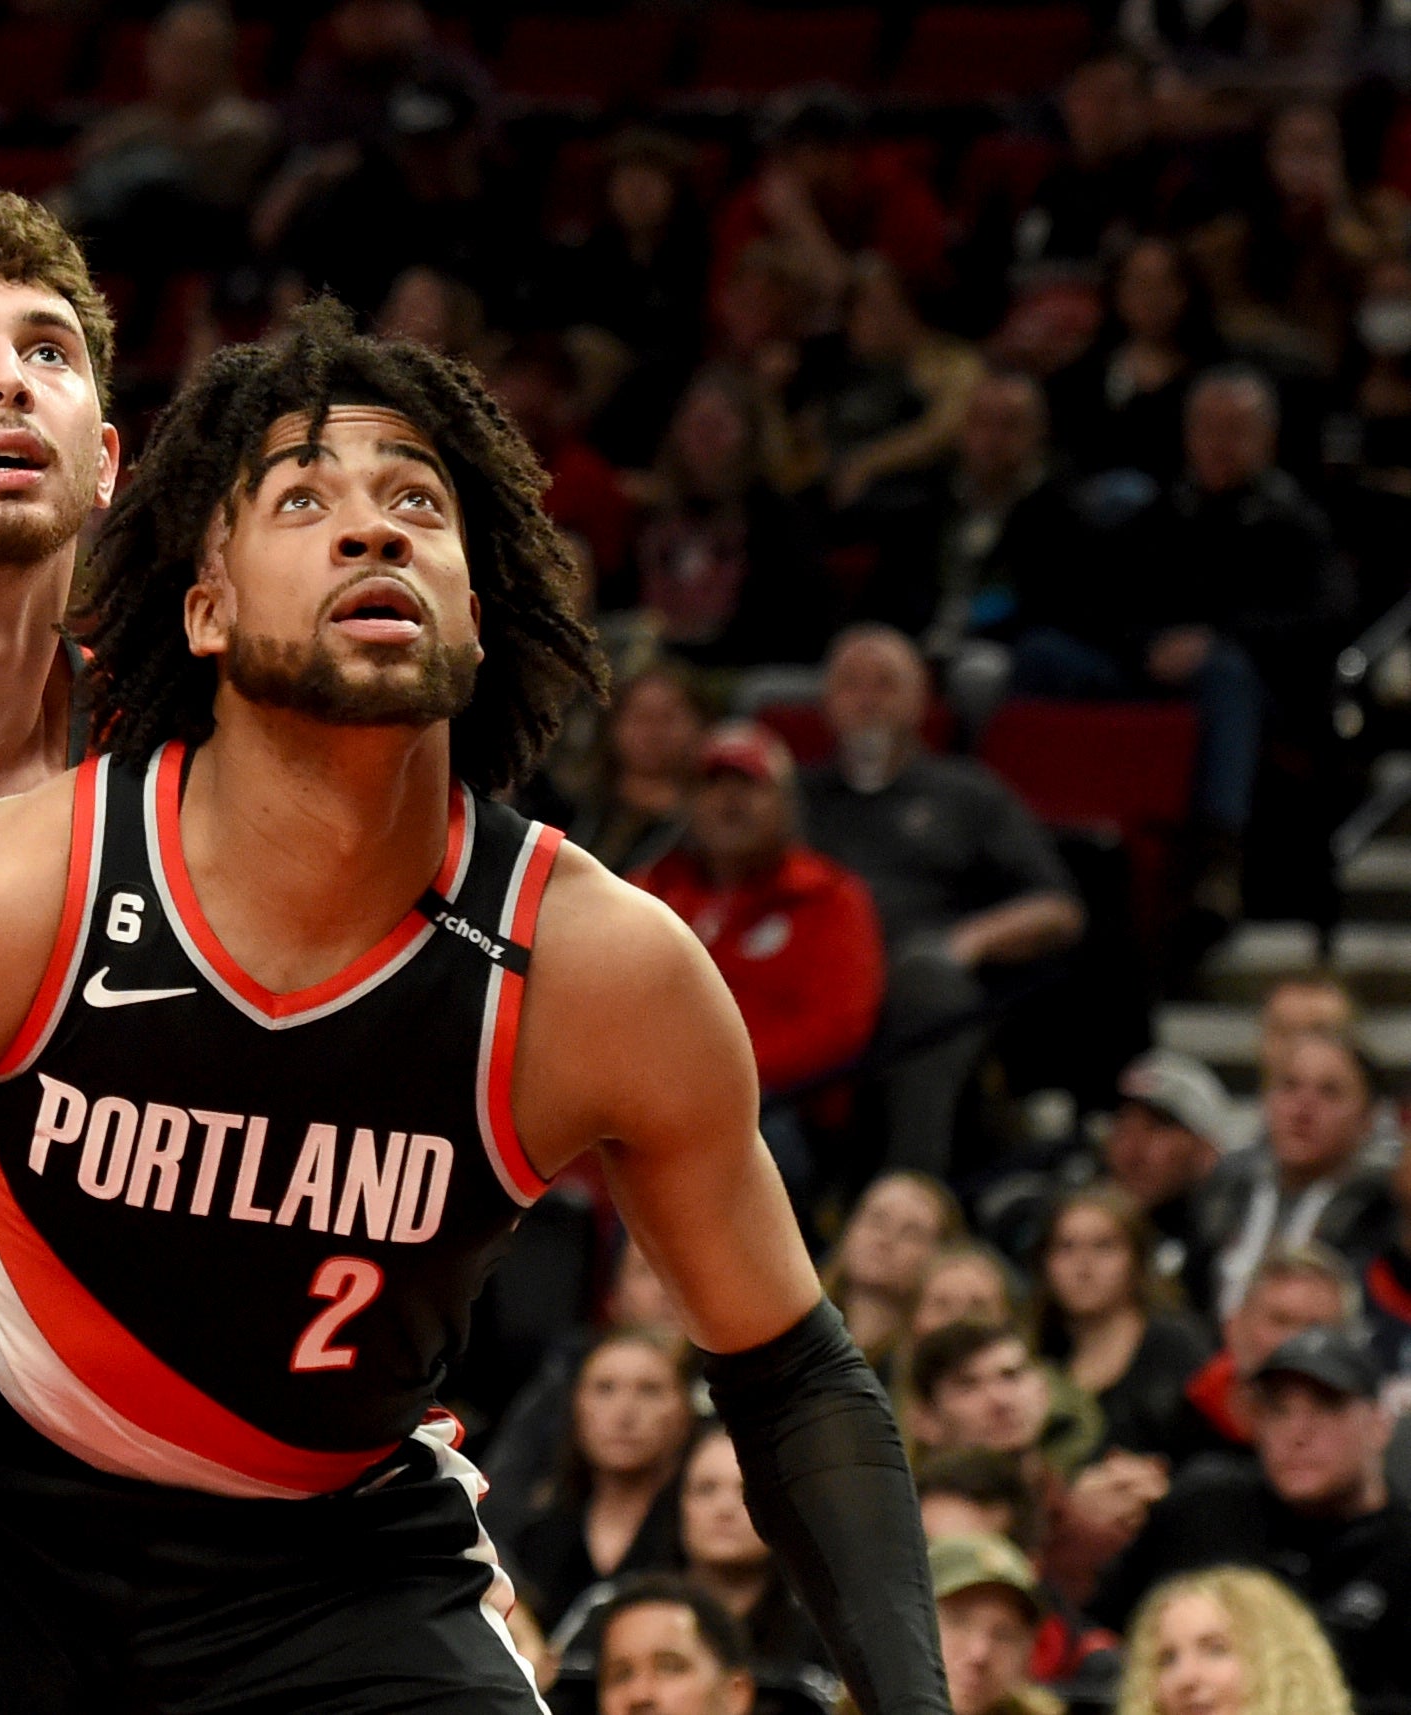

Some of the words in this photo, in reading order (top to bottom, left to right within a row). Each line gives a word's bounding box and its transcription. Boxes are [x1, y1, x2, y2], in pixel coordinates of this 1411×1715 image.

[106, 891, 145, 945] 6
[433, 911, 506, 960] schonz
[27, 1072, 455, 1244] PORTLAND
[289, 1254, 385, 1374] 2
